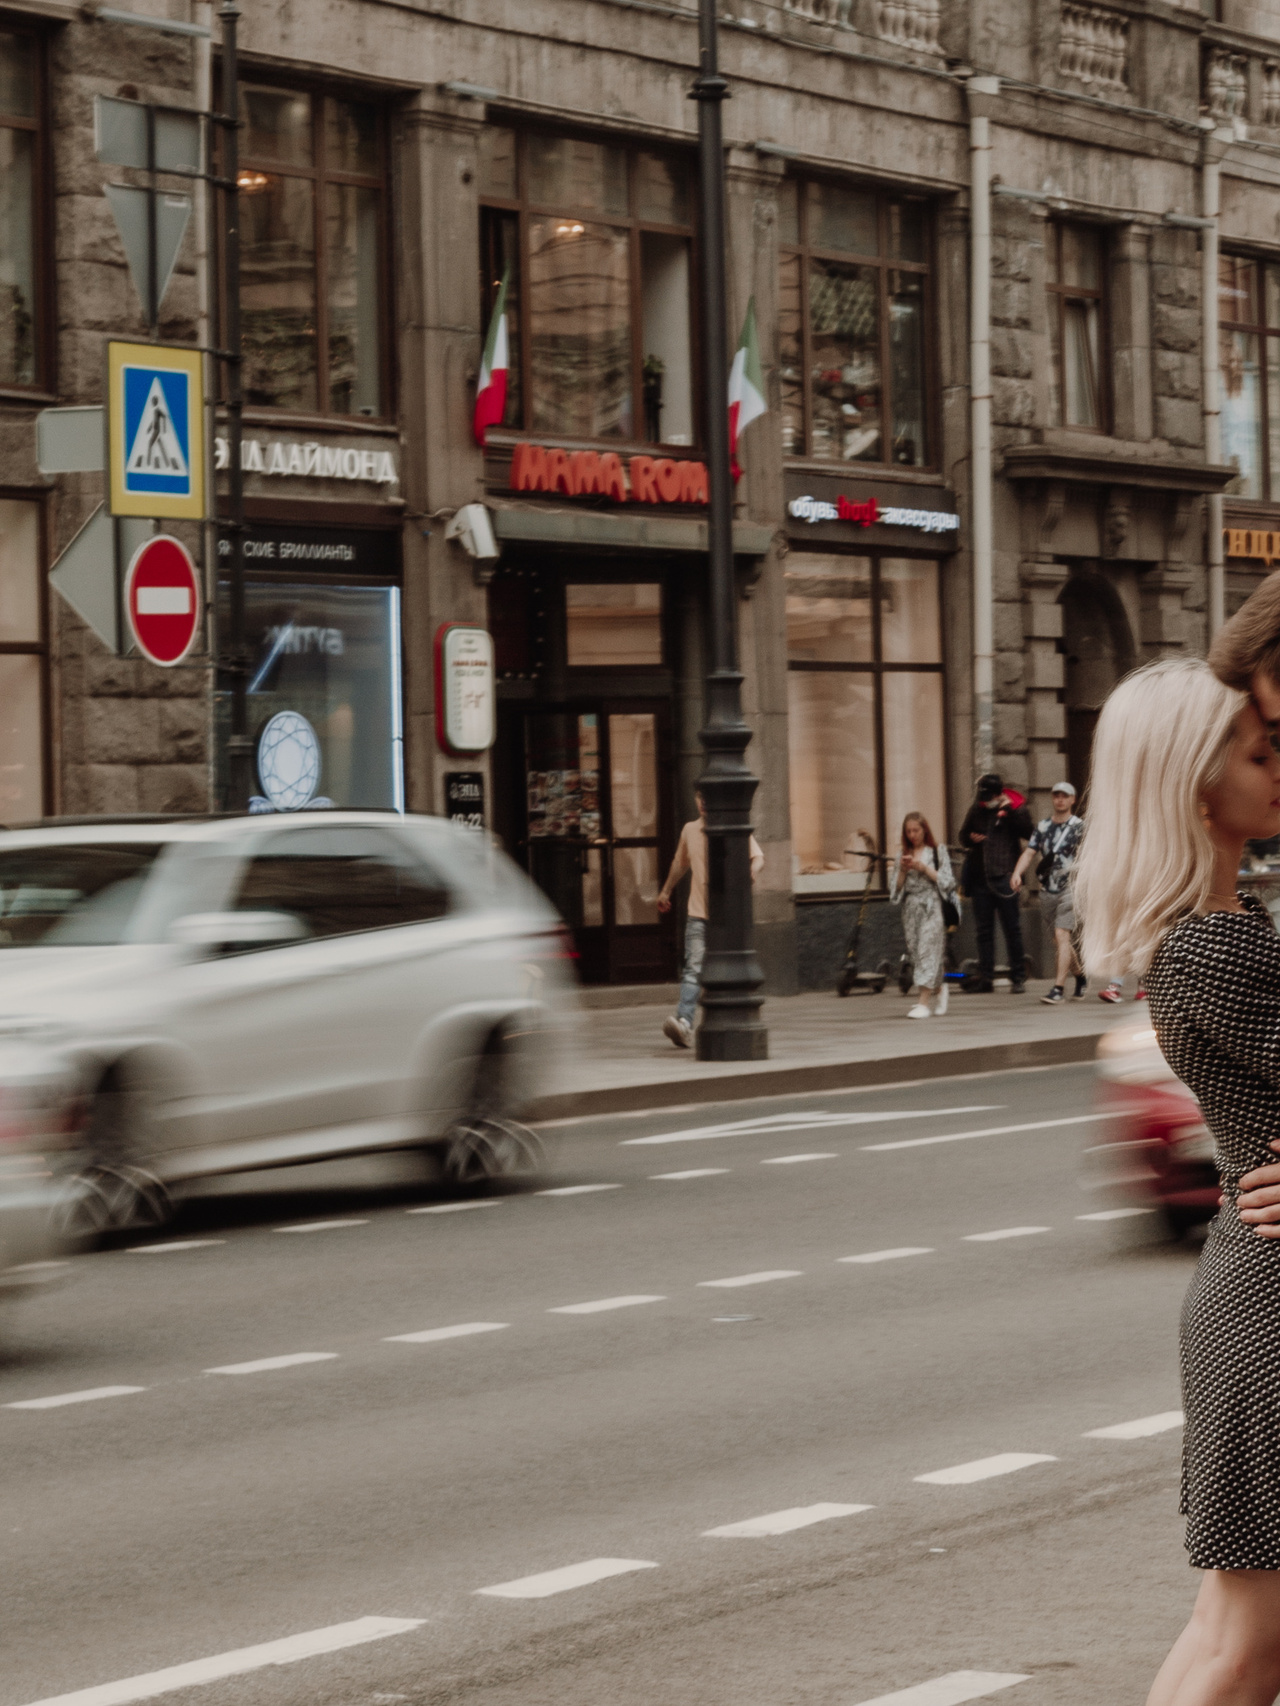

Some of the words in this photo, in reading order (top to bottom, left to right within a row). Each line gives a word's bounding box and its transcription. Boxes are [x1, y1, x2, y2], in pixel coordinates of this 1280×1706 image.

[268, 441, 398, 484] ДАЙМОНД
[788, 495, 839, 523] обувь
[878, 506, 960, 533] аксессуары
